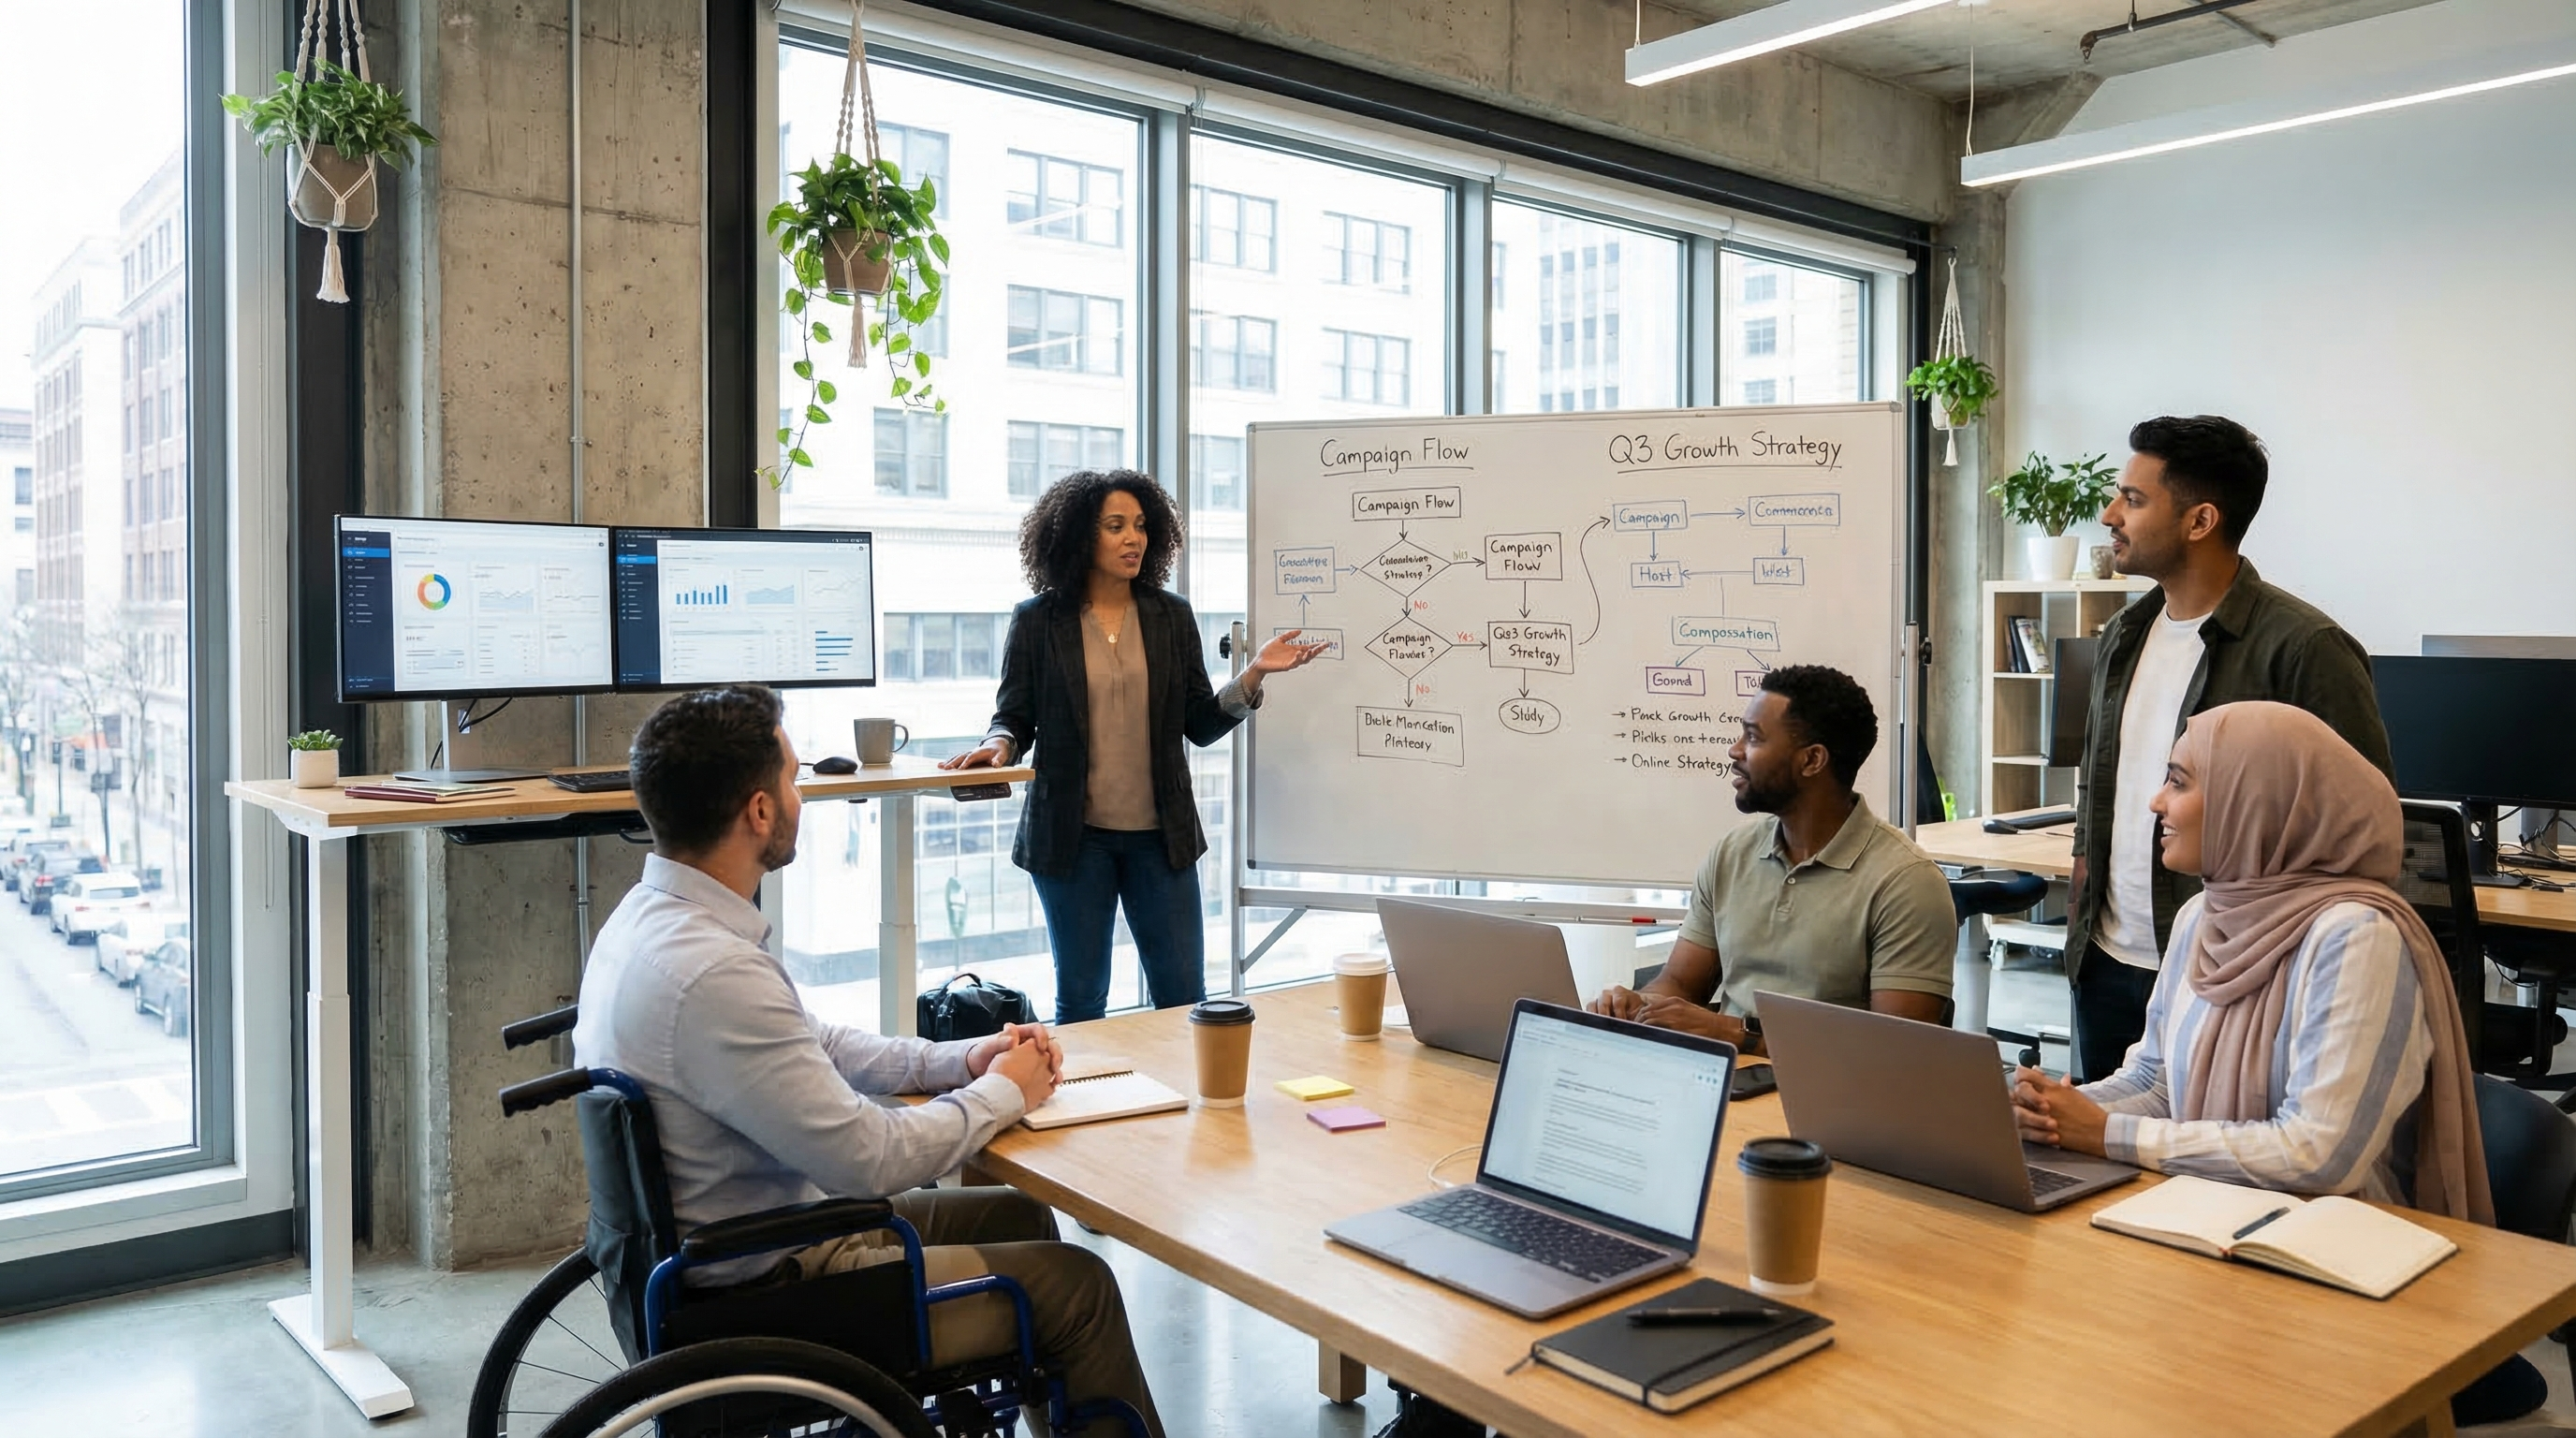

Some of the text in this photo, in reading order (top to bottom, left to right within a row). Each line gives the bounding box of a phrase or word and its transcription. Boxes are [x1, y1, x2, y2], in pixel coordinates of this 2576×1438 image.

[1320, 437, 1470, 474] Campaign Flow
[1609, 431, 1843, 472] Q3 Growth Strategy
[1357, 494, 1455, 514] Campaign Flow
[1619, 507, 1680, 529] Campaign
[1490, 539, 1552, 558] Campaign
[1524, 626, 1567, 640] Growth
[1668, 711, 1711, 723] Growth
[1632, 753, 1733, 779] Online Strategy
